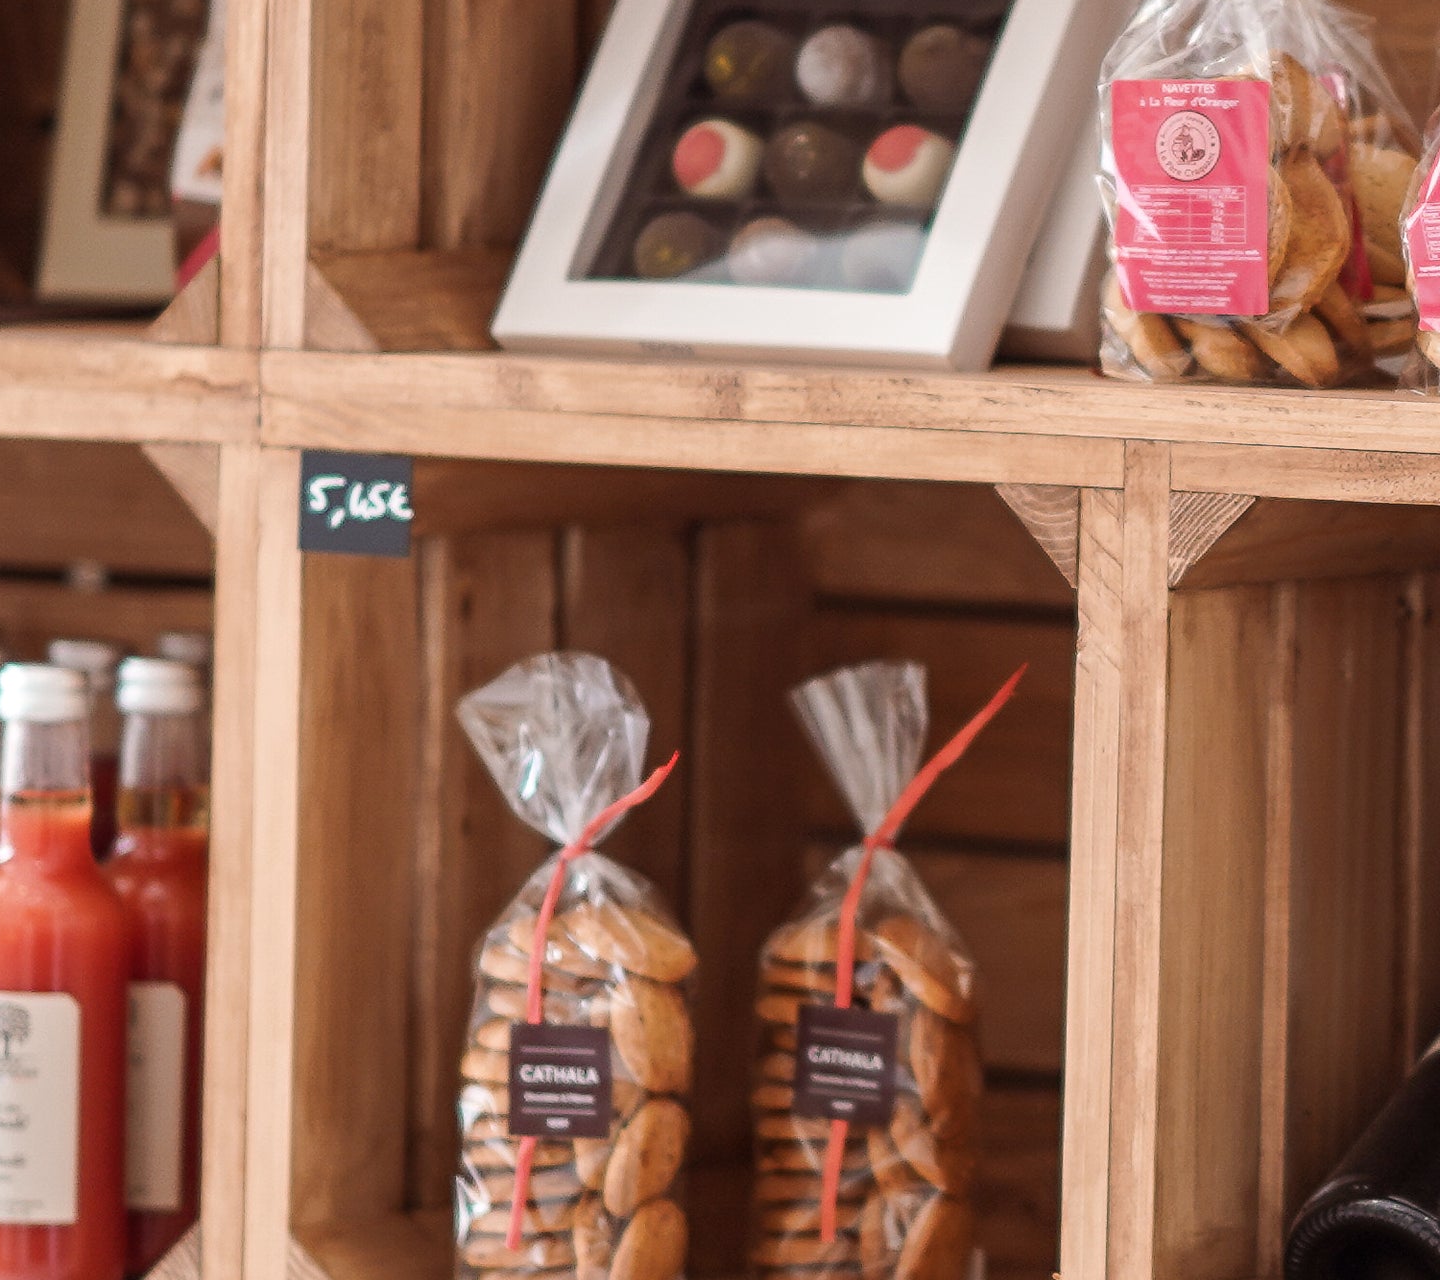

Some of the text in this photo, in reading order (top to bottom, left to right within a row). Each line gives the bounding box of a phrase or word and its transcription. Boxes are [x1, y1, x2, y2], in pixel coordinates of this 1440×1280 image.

[1161, 83, 1217, 95] NAVETTES
[309, 476, 415, 529] 5,45€
[519, 1065, 600, 1086] CATHALA
